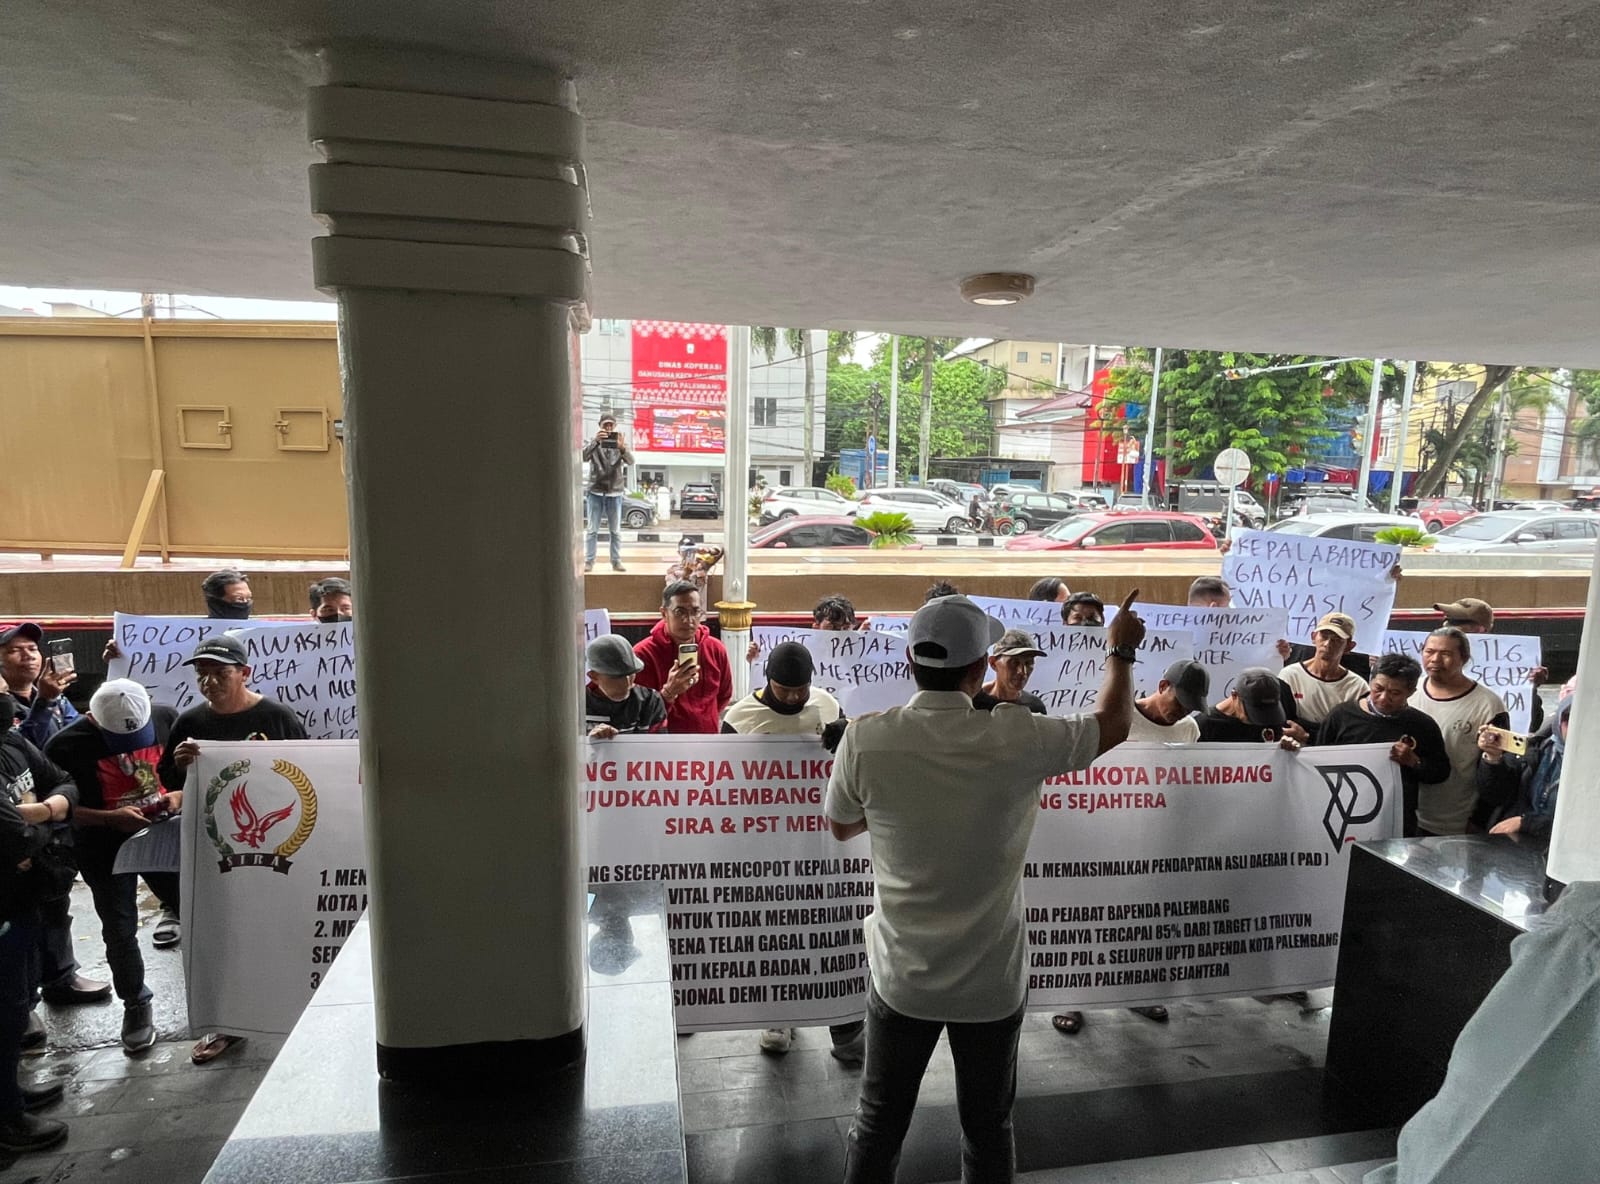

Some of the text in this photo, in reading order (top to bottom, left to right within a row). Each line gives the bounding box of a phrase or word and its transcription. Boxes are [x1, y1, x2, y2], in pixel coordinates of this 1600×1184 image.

[1238, 538, 1400, 569] KEPALA BAPENDA
[1235, 563, 1321, 587] GAGAL
[831, 631, 897, 658] PAJAK
[586, 761, 617, 782] NG
[626, 760, 734, 786] KINERJA
[1155, 764, 1273, 784] PALEMBANG
[586, 787, 1167, 813] JUDKAN PALEMBANG NG SEJAHTERA
[665, 815, 830, 834] SIRA & PST MEN
[226, 854, 279, 867] SIRA
[320, 869, 331, 887] 1.
[335, 869, 367, 886] MEN
[589, 865, 610, 882] NG
[614, 863, 706, 882] SECEPATNYA
[710, 860, 789, 879] MENCOPOT
[795, 859, 841, 876] KEPALA
[843, 858, 874, 875] BAP
[1023, 863, 1039, 878] AL
[1042, 860, 1150, 878] MEMAKSIMALKAN
[1152, 856, 1222, 873] PENDAPATAN
[1225, 854, 1248, 870] ASLI
[1250, 852, 1288, 869] DAERAH
[1297, 852, 1322, 867] PAD
[317, 894, 357, 912] KOTA
[668, 887, 709, 905] VITAL
[713, 884, 824, 904] PEMBANGUNAN
[827, 881, 875, 900] DAERAH
[314, 920, 328, 938] 2.
[716, 910, 761, 928] TIDAK
[765, 905, 853, 927] MEMBERIKAN
[1025, 908, 1049, 923] DA
[1052, 906, 1105, 923] PEJABAT
[1107, 903, 1161, 921] BAPENDA
[1163, 899, 1230, 918] PALEMBANG
[669, 937, 705, 955] RENA
[709, 935, 755, 953] TELAH
[758, 932, 806, 951] GAGAL
[809, 929, 850, 948] DALAM
[1028, 930, 1047, 946] NG
[1050, 929, 1092, 945] HANYA
[1095, 925, 1153, 944] TERCAPAI
[1155, 923, 1181, 941] 85%
[1184, 921, 1211, 938] DARI
[1213, 918, 1252, 935] TARGET
[1269, 913, 1312, 930] TRILYUN
[310, 972, 321, 990] 3
[672, 962, 698, 981] NTI
[702, 960, 756, 980] KEPALA
[760, 958, 810, 977] BADAN
[821, 954, 856, 975] KABID
[1071, 951, 1094, 966] PDL
[1097, 952, 1106, 965] &
[1109, 947, 1163, 965] SELURUH
[1165, 944, 1195, 961] UPTD
[1198, 939, 1247, 958] BAPENDA
[1249, 937, 1274, 953] KOTA
[1276, 932, 1339, 950] PALEMBANG
[673, 962, 1230, 1007] SIONAL DEMI TERWUJUDNYA BERDJAYA PALEMBANG SEJAHTERA
